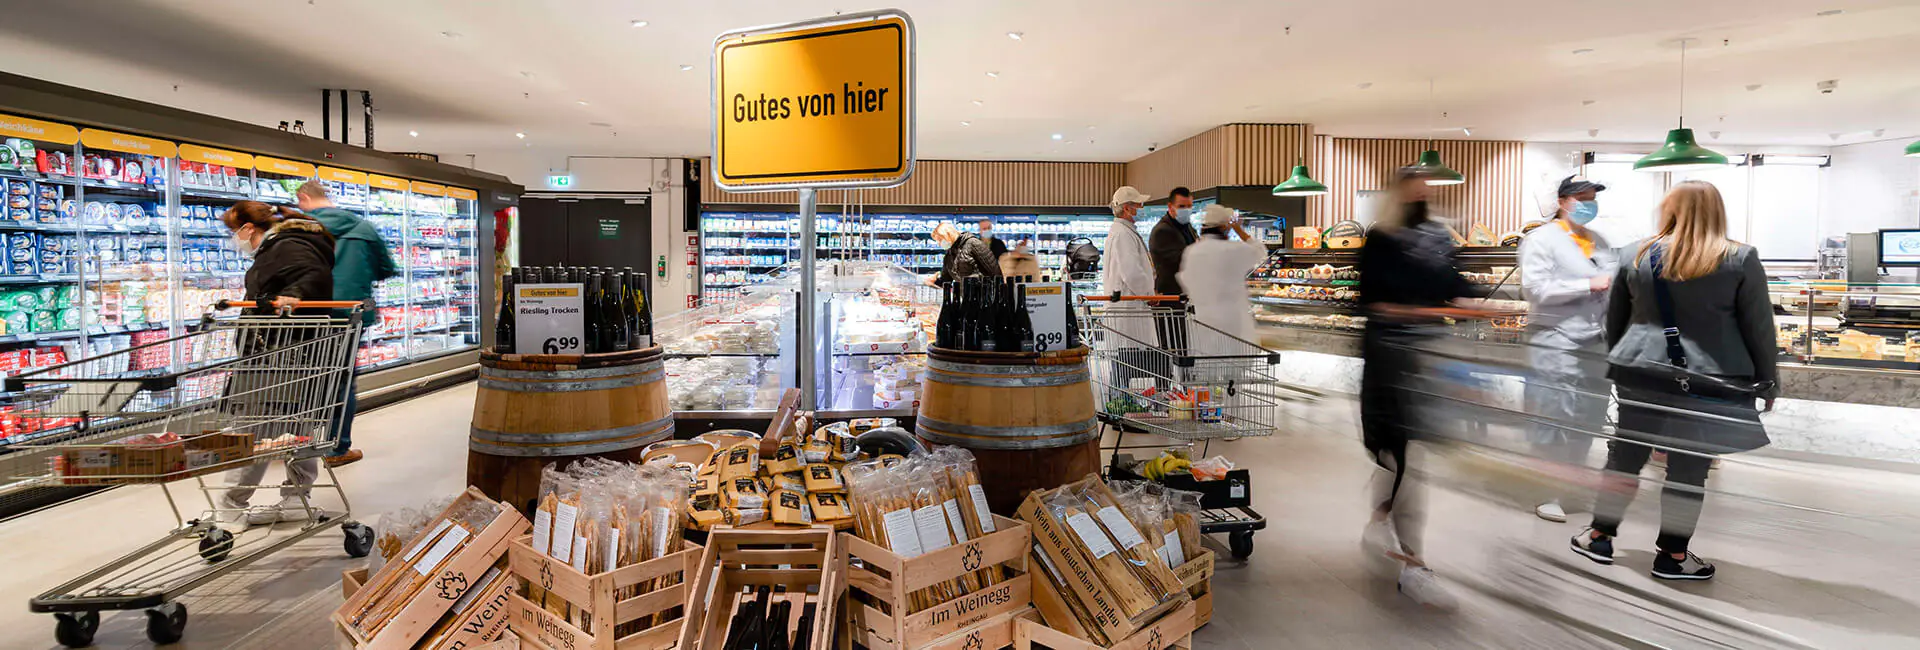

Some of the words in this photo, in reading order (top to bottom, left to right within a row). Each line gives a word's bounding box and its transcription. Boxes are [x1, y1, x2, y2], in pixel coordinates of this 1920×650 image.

[733, 93, 791, 123] Gutes
[797, 92, 836, 118] von
[843, 81, 889, 115] hier
[520, 307, 549, 315] Riesling
[551, 306, 579, 314] Trocken
[557, 288, 567, 296] hier
[1033, 506, 1050, 532] Wein
[1048, 530, 1061, 549] aus
[1060, 546, 1096, 593] deutschen
[1092, 590, 1121, 628] Landen
[463, 585, 513, 634] Weine
[930, 608, 950, 625] Im
[954, 585, 1011, 616] Weinegg
[481, 611, 511, 642] RHEING
[536, 611, 575, 650] Weinegg
